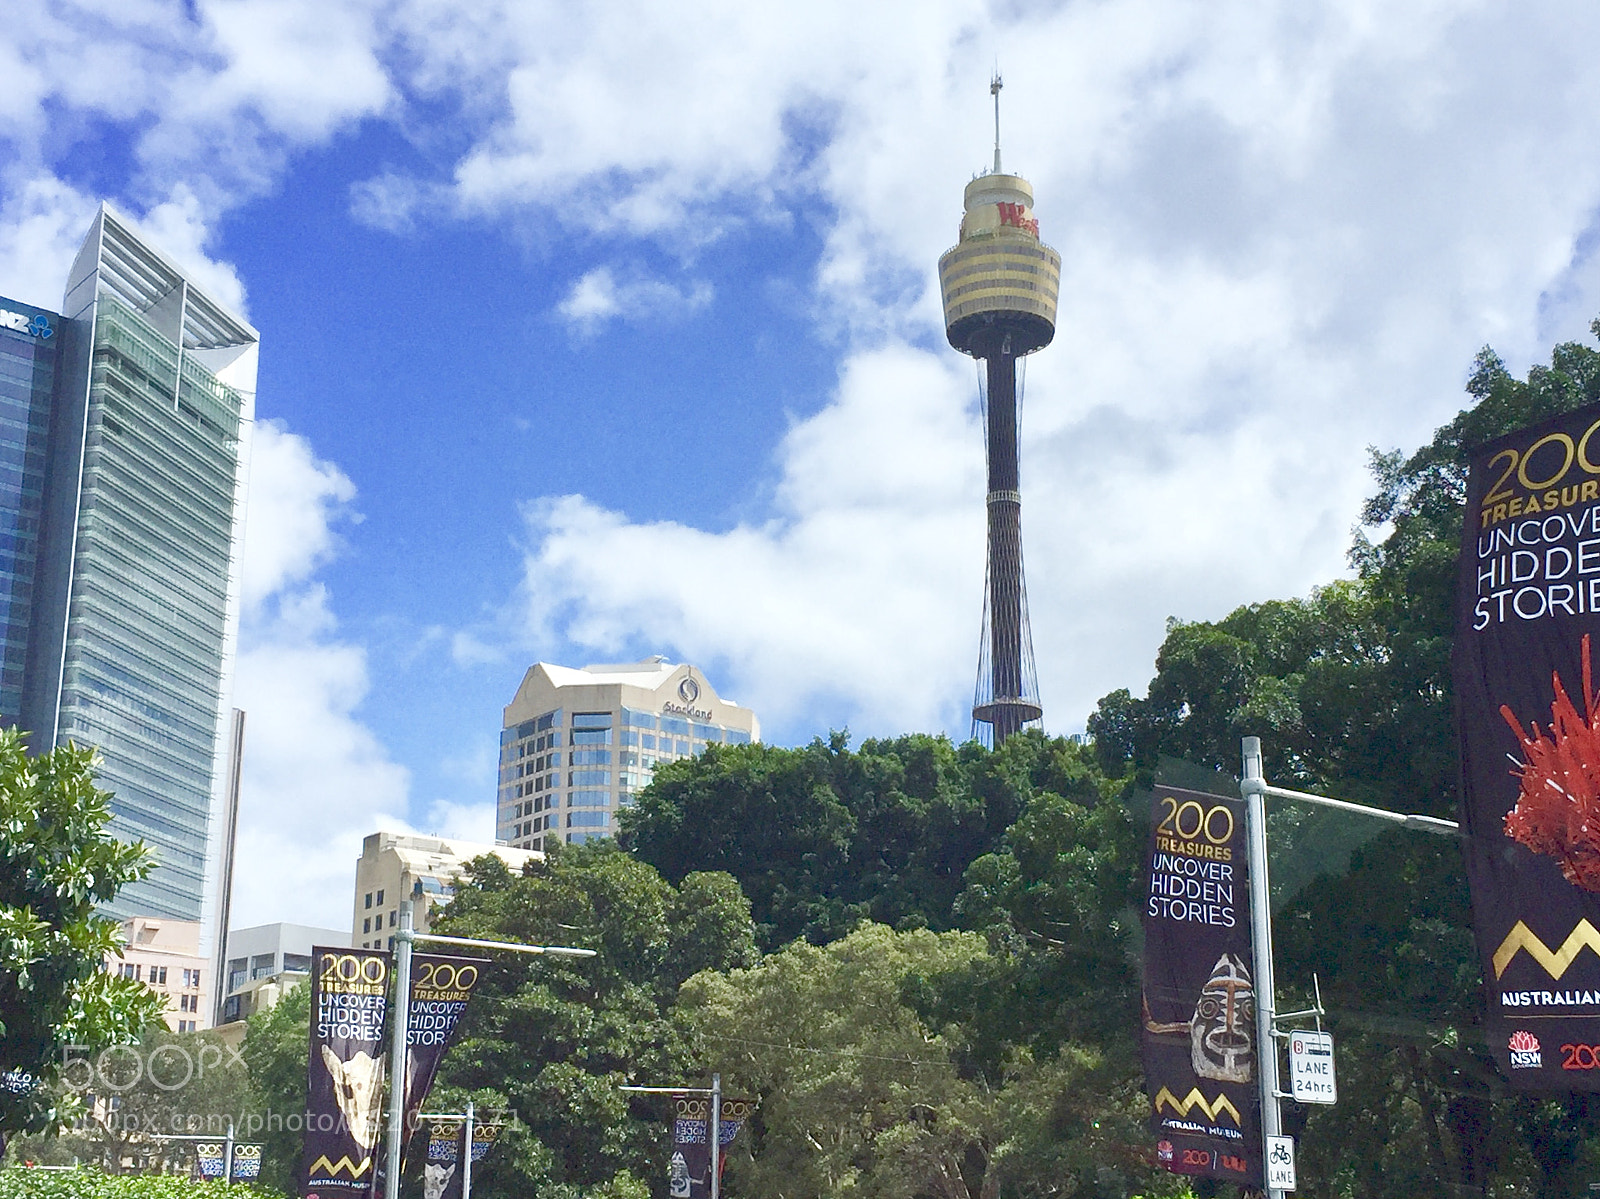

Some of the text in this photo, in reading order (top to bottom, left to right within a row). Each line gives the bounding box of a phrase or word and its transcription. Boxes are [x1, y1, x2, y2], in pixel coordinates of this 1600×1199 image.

[1481, 480, 1598, 528] TREASUR
[1477, 539, 1600, 595] HIDDE
[664, 702, 712, 720] Stockland
[1156, 796, 1234, 845] 200
[1156, 836, 1232, 861] TREASURES
[1153, 853, 1233, 882] UNCOVER
[1151, 873, 1233, 904] HIDDEN
[1149, 896, 1236, 928] STORIES
[320, 953, 386, 984] 200
[415, 962, 478, 991] 200
[319, 982, 385, 995] TREASURES
[414, 990, 470, 1001] TREASURES
[318, 993, 386, 1010] UNCOVER
[318, 1008, 385, 1025] HIDDEN
[317, 1023, 382, 1042] STORIES
[1511, 1052, 1541, 1064] NSW
[1297, 1061, 1328, 1075] LANE
[1296, 1080, 1332, 1093] 24hrs
[1183, 1149, 1210, 1166] 200
[1270, 1170, 1292, 1183] LANE
